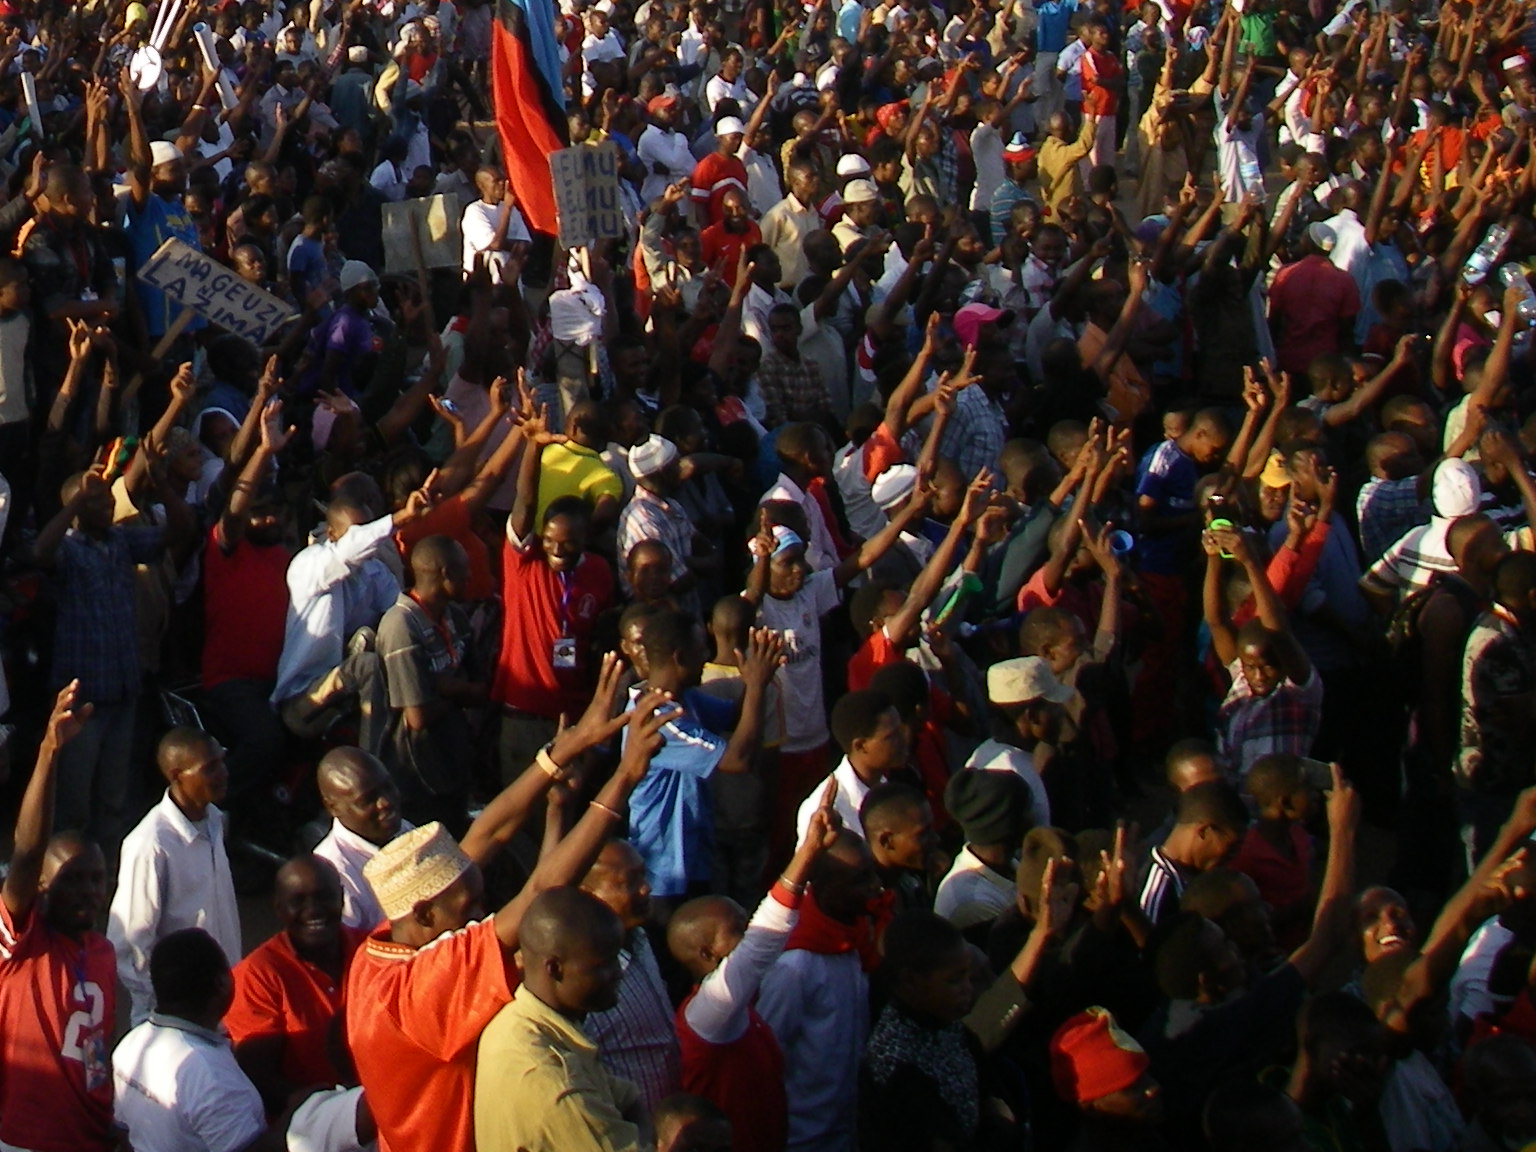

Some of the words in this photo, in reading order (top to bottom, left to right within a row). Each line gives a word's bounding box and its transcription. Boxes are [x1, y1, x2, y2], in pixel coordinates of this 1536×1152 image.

[144, 251, 266, 346] LAZIMA
[176, 252, 286, 326] MAGEUZI
[61, 981, 104, 1062] 2
